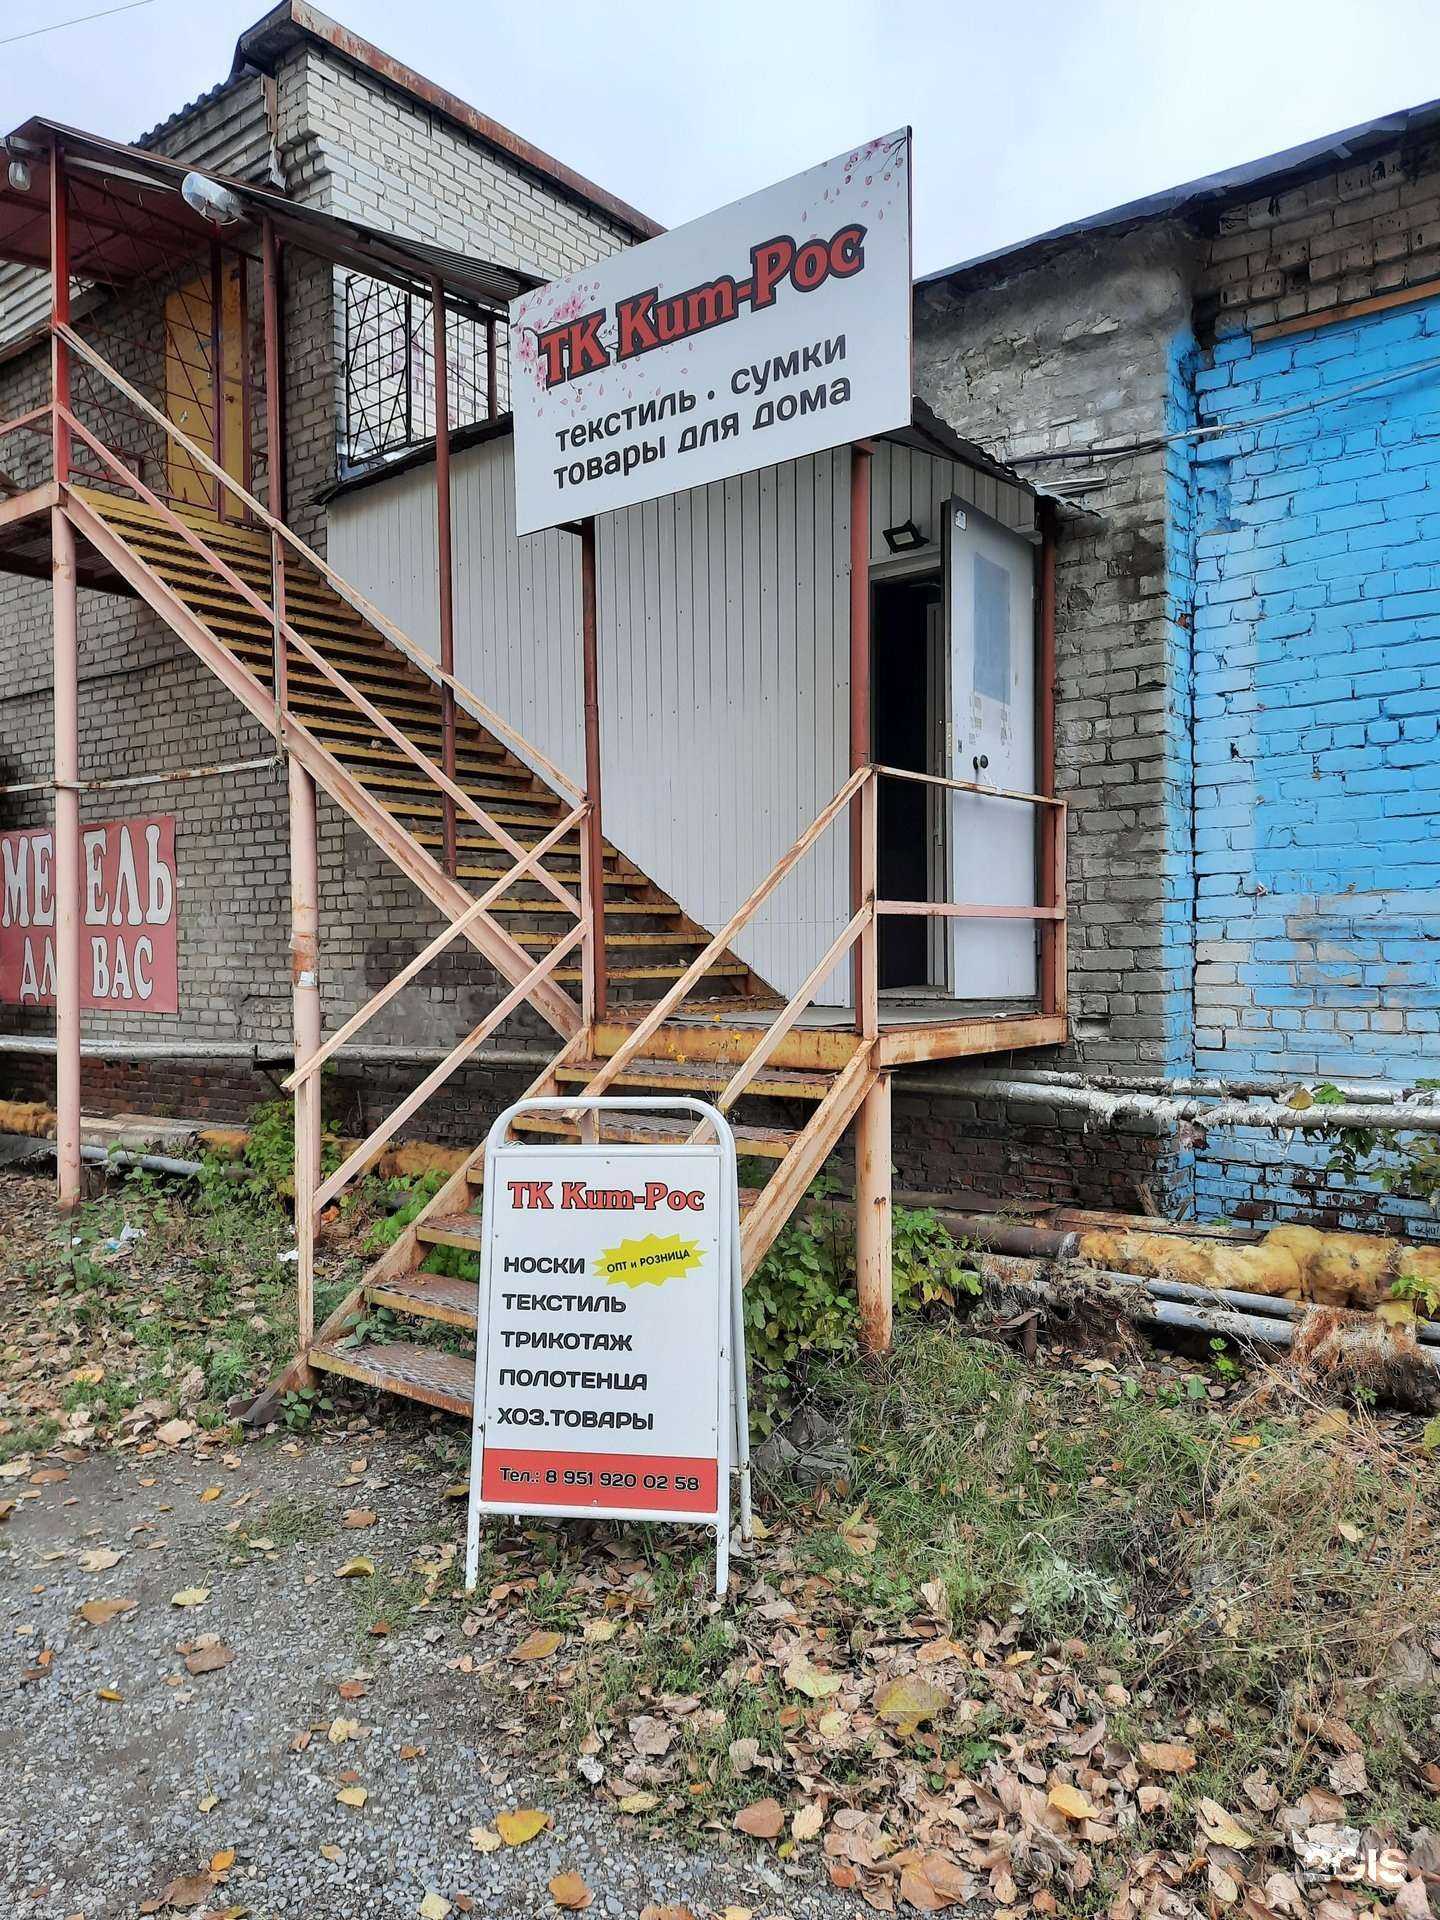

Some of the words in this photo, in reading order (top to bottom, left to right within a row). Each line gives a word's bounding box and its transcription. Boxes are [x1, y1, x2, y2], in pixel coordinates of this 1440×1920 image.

[538, 309, 610, 388] ТК
[555, 386, 697, 452] текстиль
[730, 334, 847, 396] сумки
[553, 434, 666, 490] товары
[677, 412, 740, 454] для
[752, 377, 852, 430] дома
[2, 824, 173, 928] МЕЕЛЬ
[20, 936, 66, 1003] ДЛ
[91, 935, 153, 1000] ВАС
[507, 1181, 554, 1210] ТК
[503, 1256, 585, 1274] НОСКИ
[606, 1260, 628, 1273] ОПТ
[630, 1260, 638, 1269] и
[640, 1248, 691, 1267] РОЗНИЦА
[502, 1293, 627, 1313] ТЕКСТИЛЬ
[500, 1331, 633, 1352] ТРИКОТАЖ
[499, 1369, 648, 1391] ПОЛОТЕНЦА
[497, 1408, 654, 1431] ХОЗ.ТОВАРЫ
[500, 1467, 542, 1484] Тел.:
[545, 1469, 558, 1484] 8
[563, 1470, 593, 1486] 951
[599, 1472, 637, 1488] 920
[642, 1474, 669, 1490] 02
[674, 1475, 700, 1491] 58
